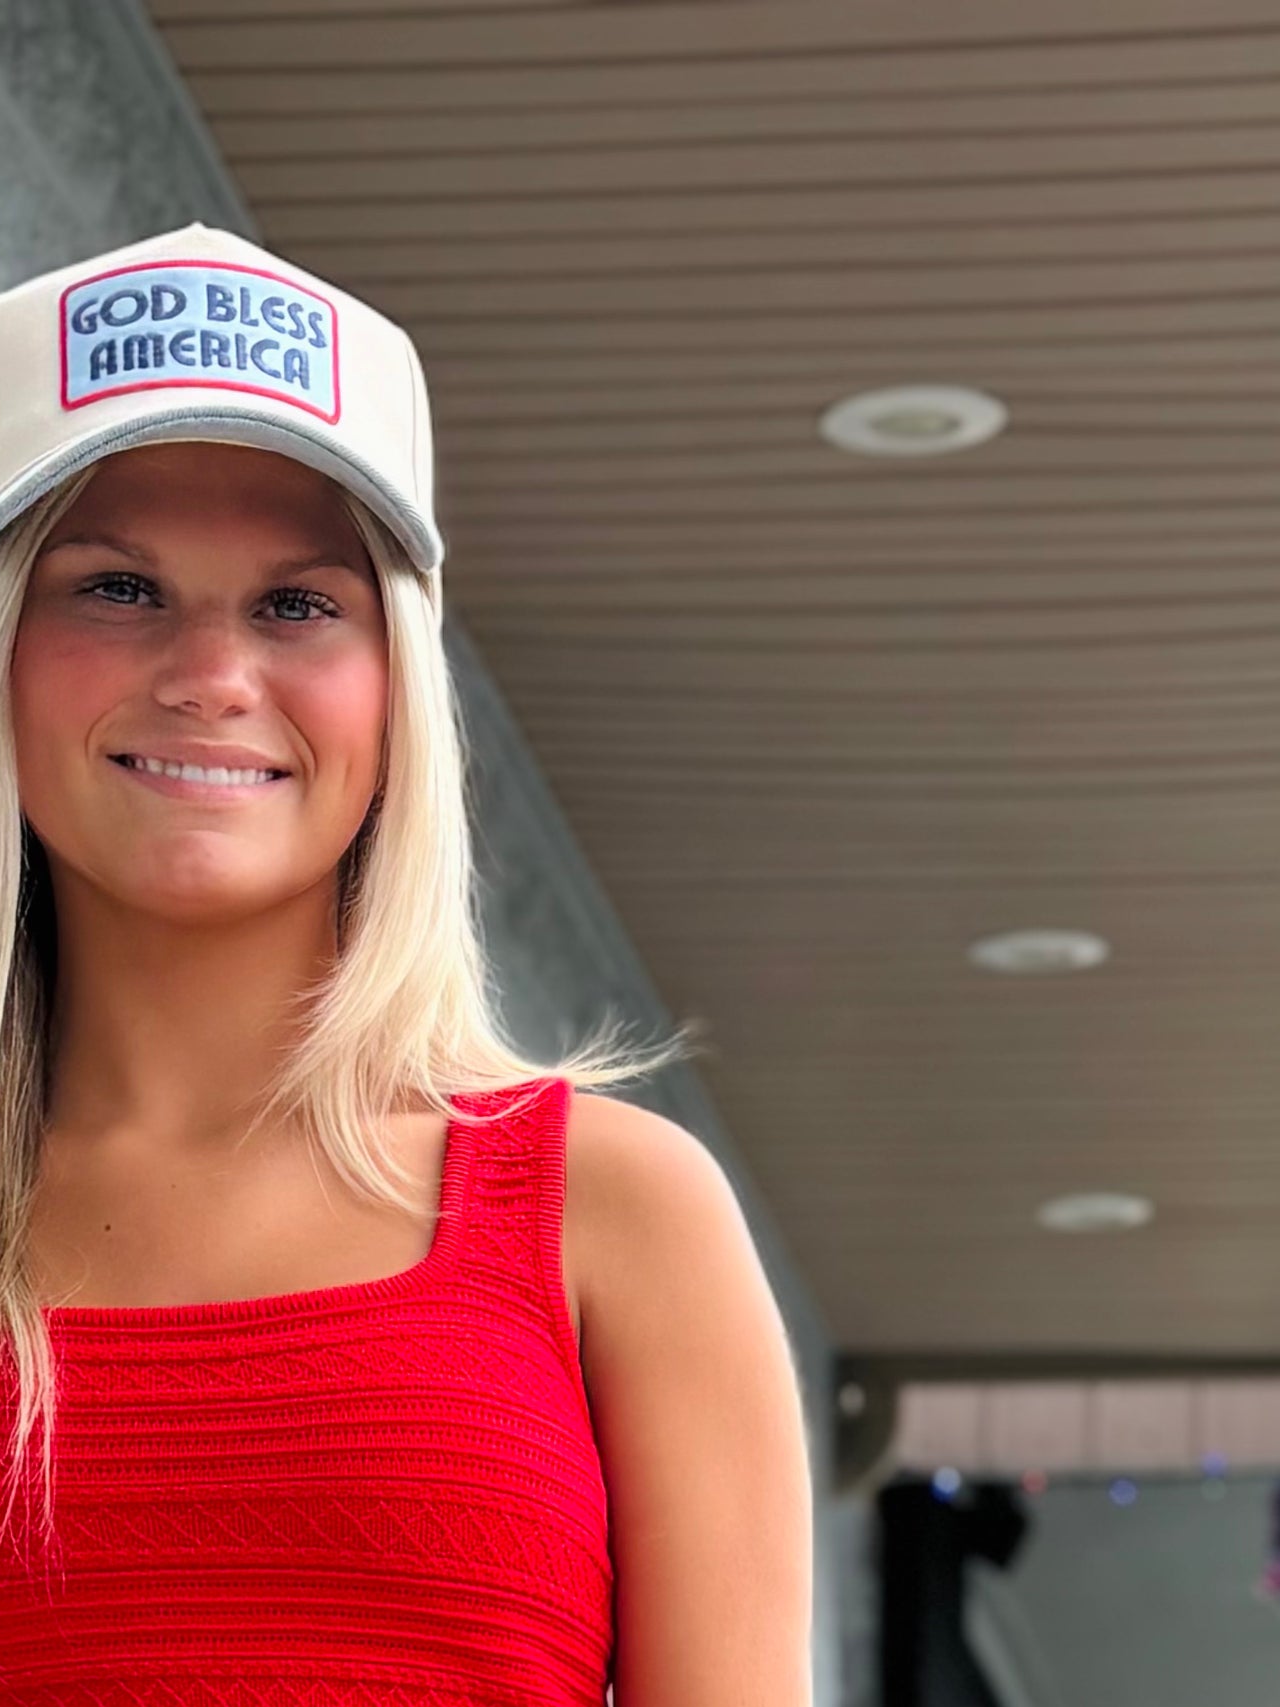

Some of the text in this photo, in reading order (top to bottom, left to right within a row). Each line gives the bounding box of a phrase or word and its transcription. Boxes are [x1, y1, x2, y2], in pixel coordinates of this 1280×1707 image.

[71, 284, 328, 349] GOD BLESS
[89, 329, 310, 390] AMERICA
